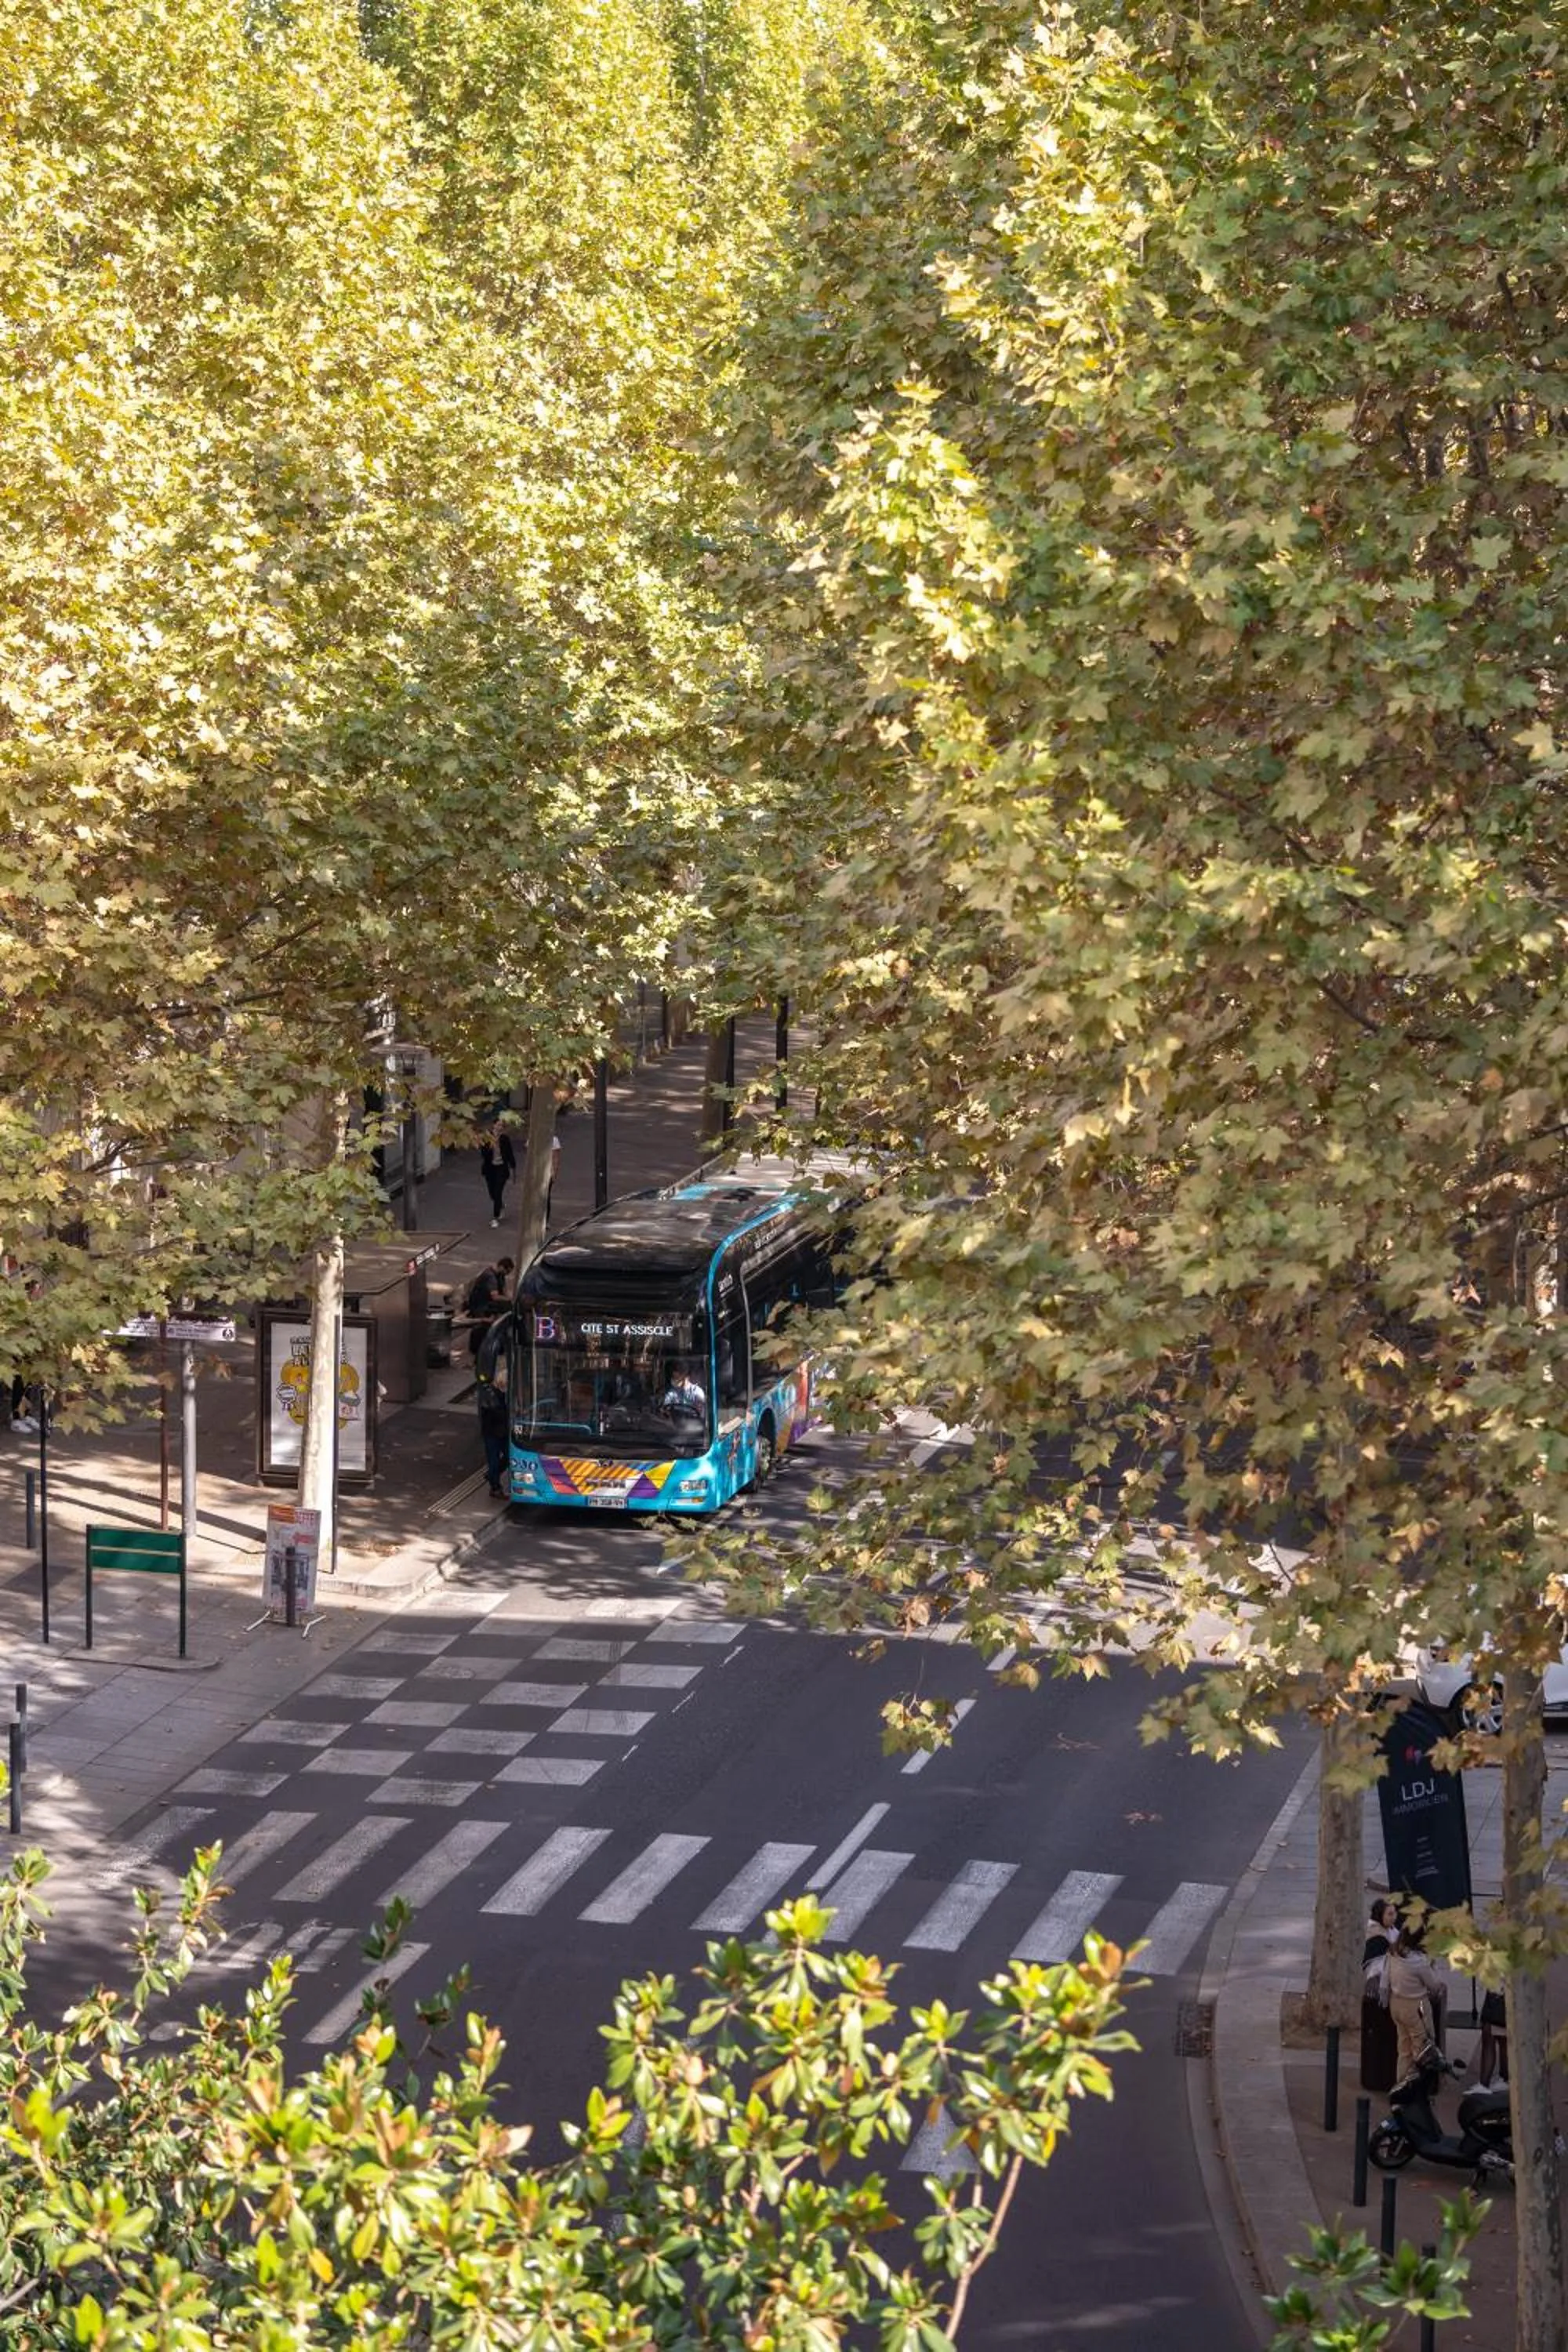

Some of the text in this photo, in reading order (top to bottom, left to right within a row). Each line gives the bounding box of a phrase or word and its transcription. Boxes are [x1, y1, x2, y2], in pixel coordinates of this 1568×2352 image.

[536, 1316, 555, 1339] B
[580, 1323, 603, 1334] CITE
[606, 1324, 619, 1334] ST
[1401, 1777, 1436, 1802] LDJ
